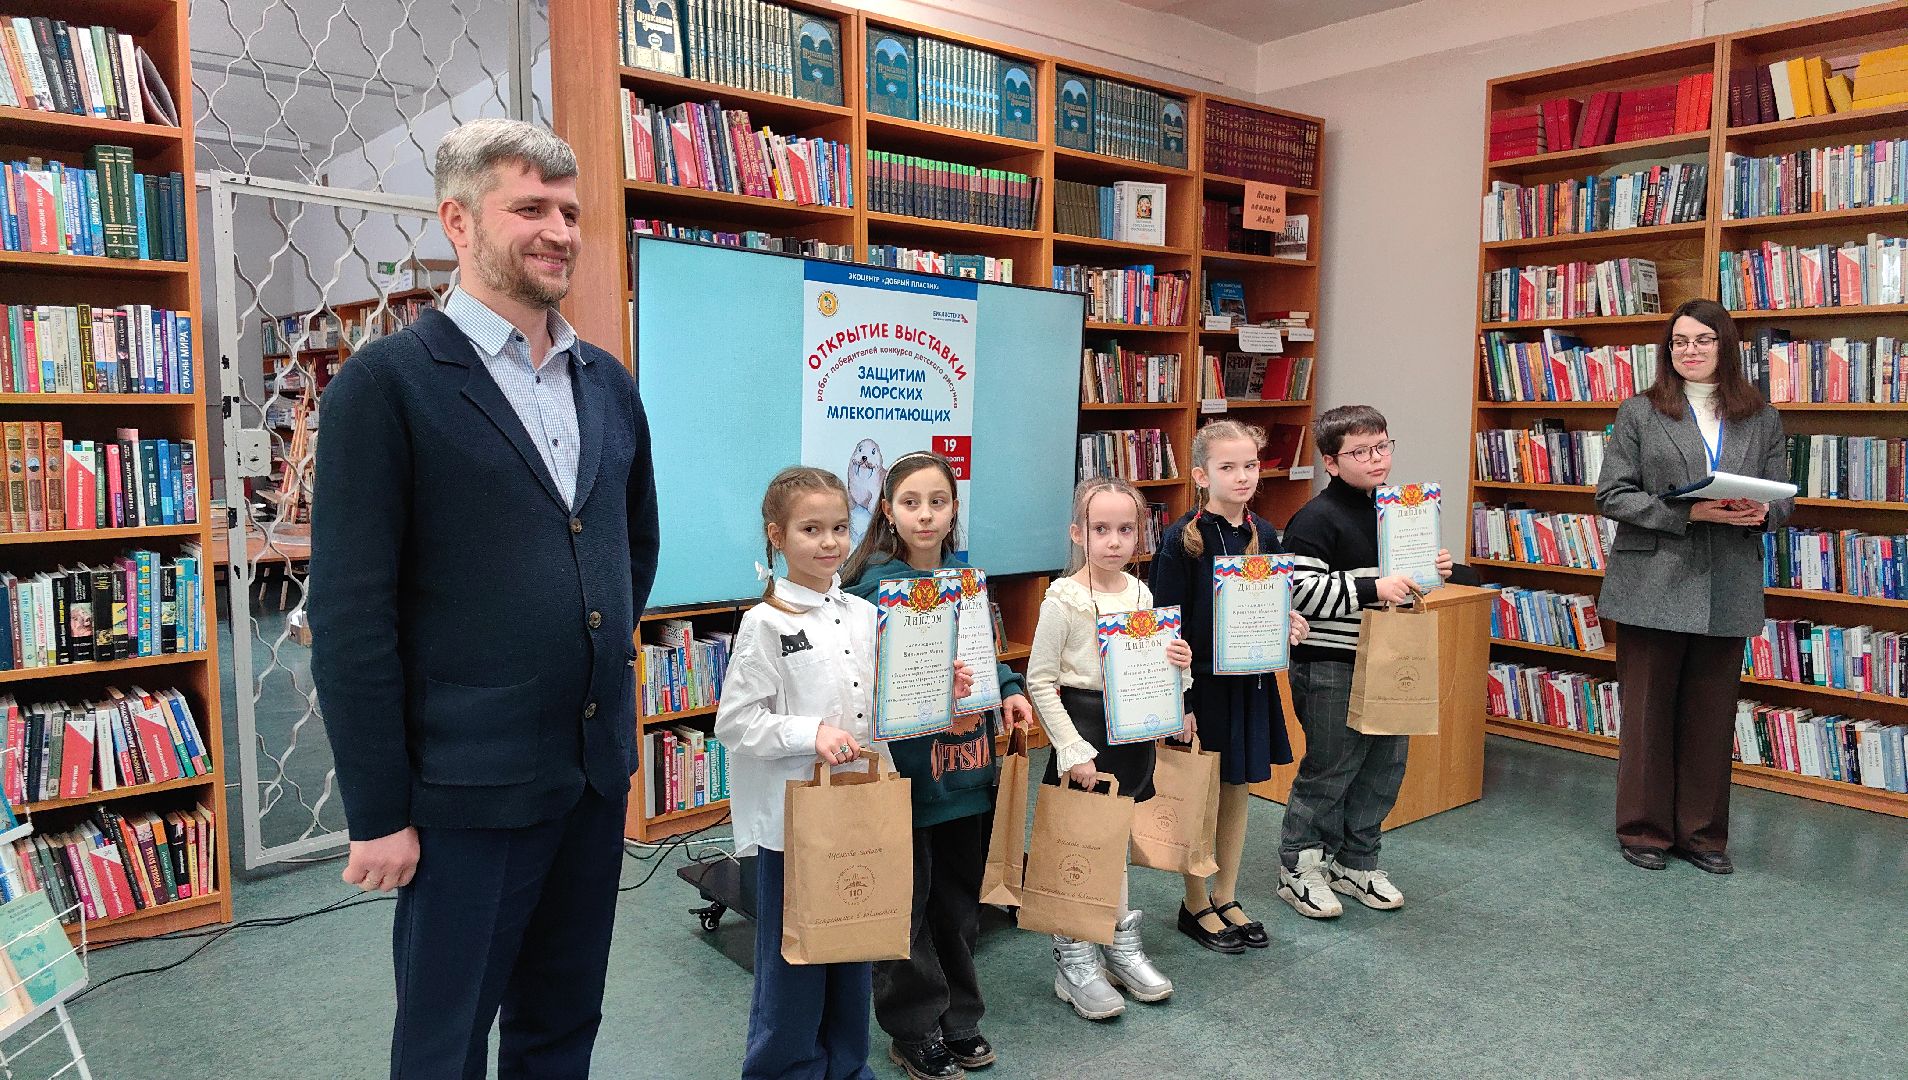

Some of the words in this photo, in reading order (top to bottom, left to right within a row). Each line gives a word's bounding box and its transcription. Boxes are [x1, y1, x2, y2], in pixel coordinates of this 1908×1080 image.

[38, 208, 48, 245] Химические
[848, 273, 880, 283] ЭКОЦЕНТР
[180, 331, 189, 357] МИРА
[808, 323, 888, 370] ОТКРЫТИЕ
[894, 324, 967, 381] ВЫСТАВКИ
[180, 360, 190, 389] СТРАНЫ
[817, 373, 830, 402] работ
[830, 346, 878, 374] победителей
[880, 346, 913, 357] конкурса
[914, 352, 944, 374] детского
[943, 374, 958, 408] рисунка
[858, 366, 926, 383] ЗАЩИТИМ
[859, 386, 923, 400] МОРСКИХ
[826, 406, 951, 424] МЛЕКОПИТАЮЩИХ
[944, 438, 957, 452] 19
[710, 748, 719, 799] Справочник
[849, 889, 863, 897] 110
